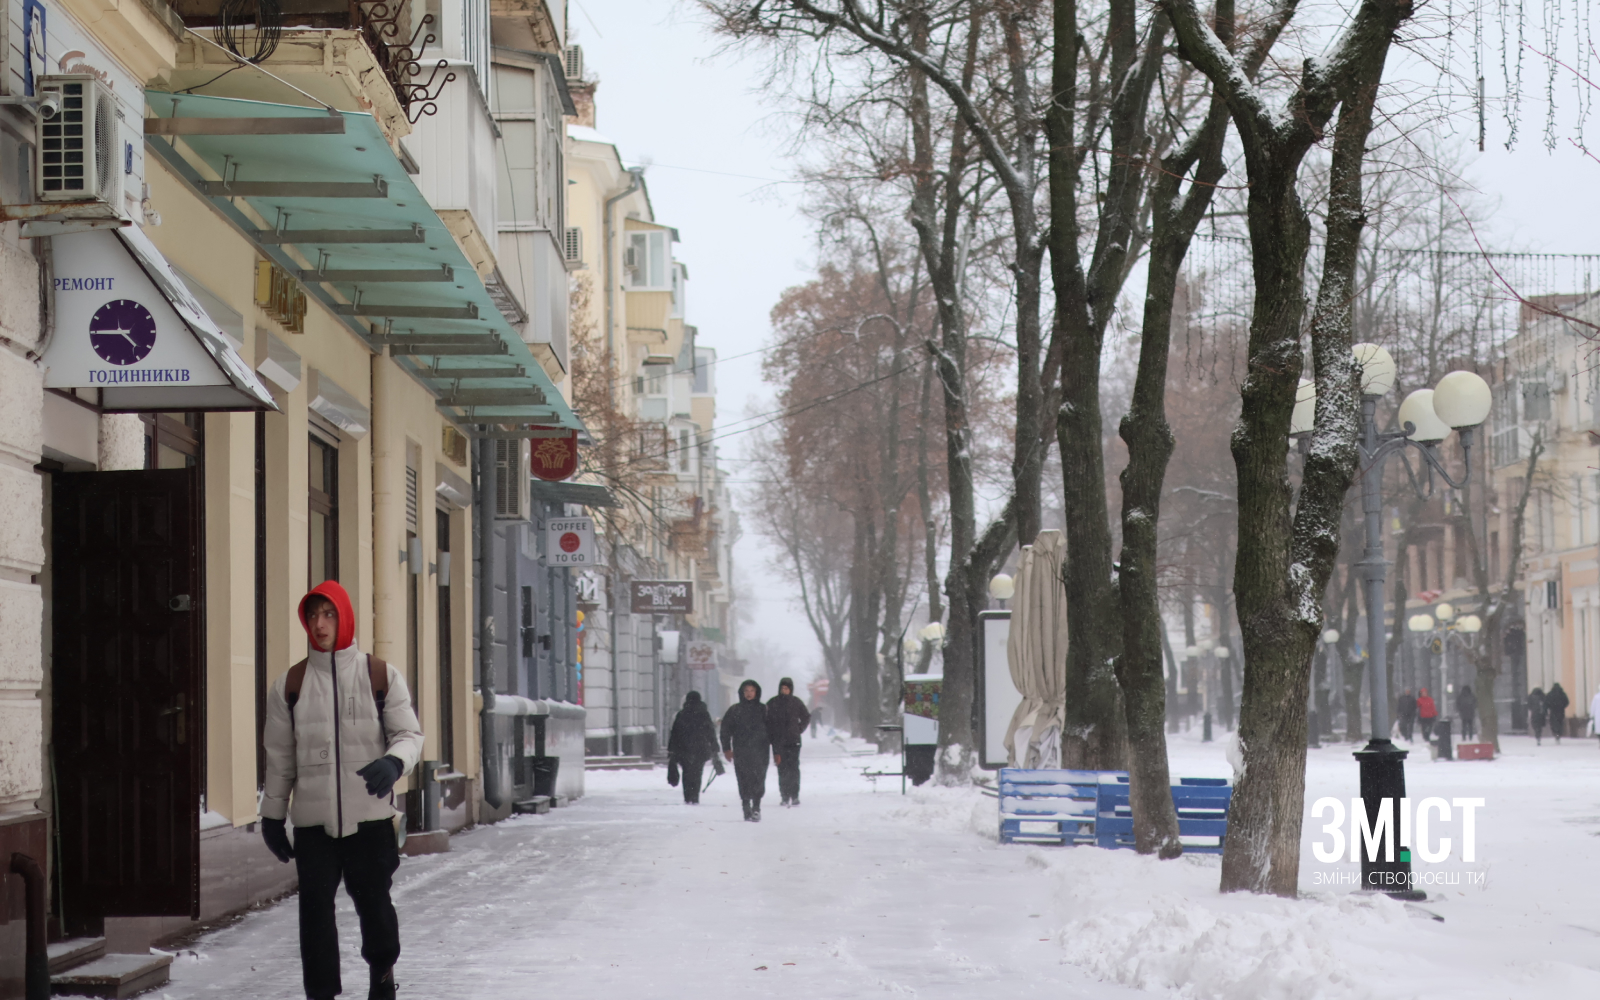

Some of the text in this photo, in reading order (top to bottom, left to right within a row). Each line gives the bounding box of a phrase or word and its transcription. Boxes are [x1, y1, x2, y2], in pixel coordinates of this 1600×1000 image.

[54, 277, 115, 291] РЕМОНТ
[88, 368, 191, 385] ГОДИННИКІВ
[551, 522, 587, 531] COFFEE
[555, 553, 585, 563] TO GO
